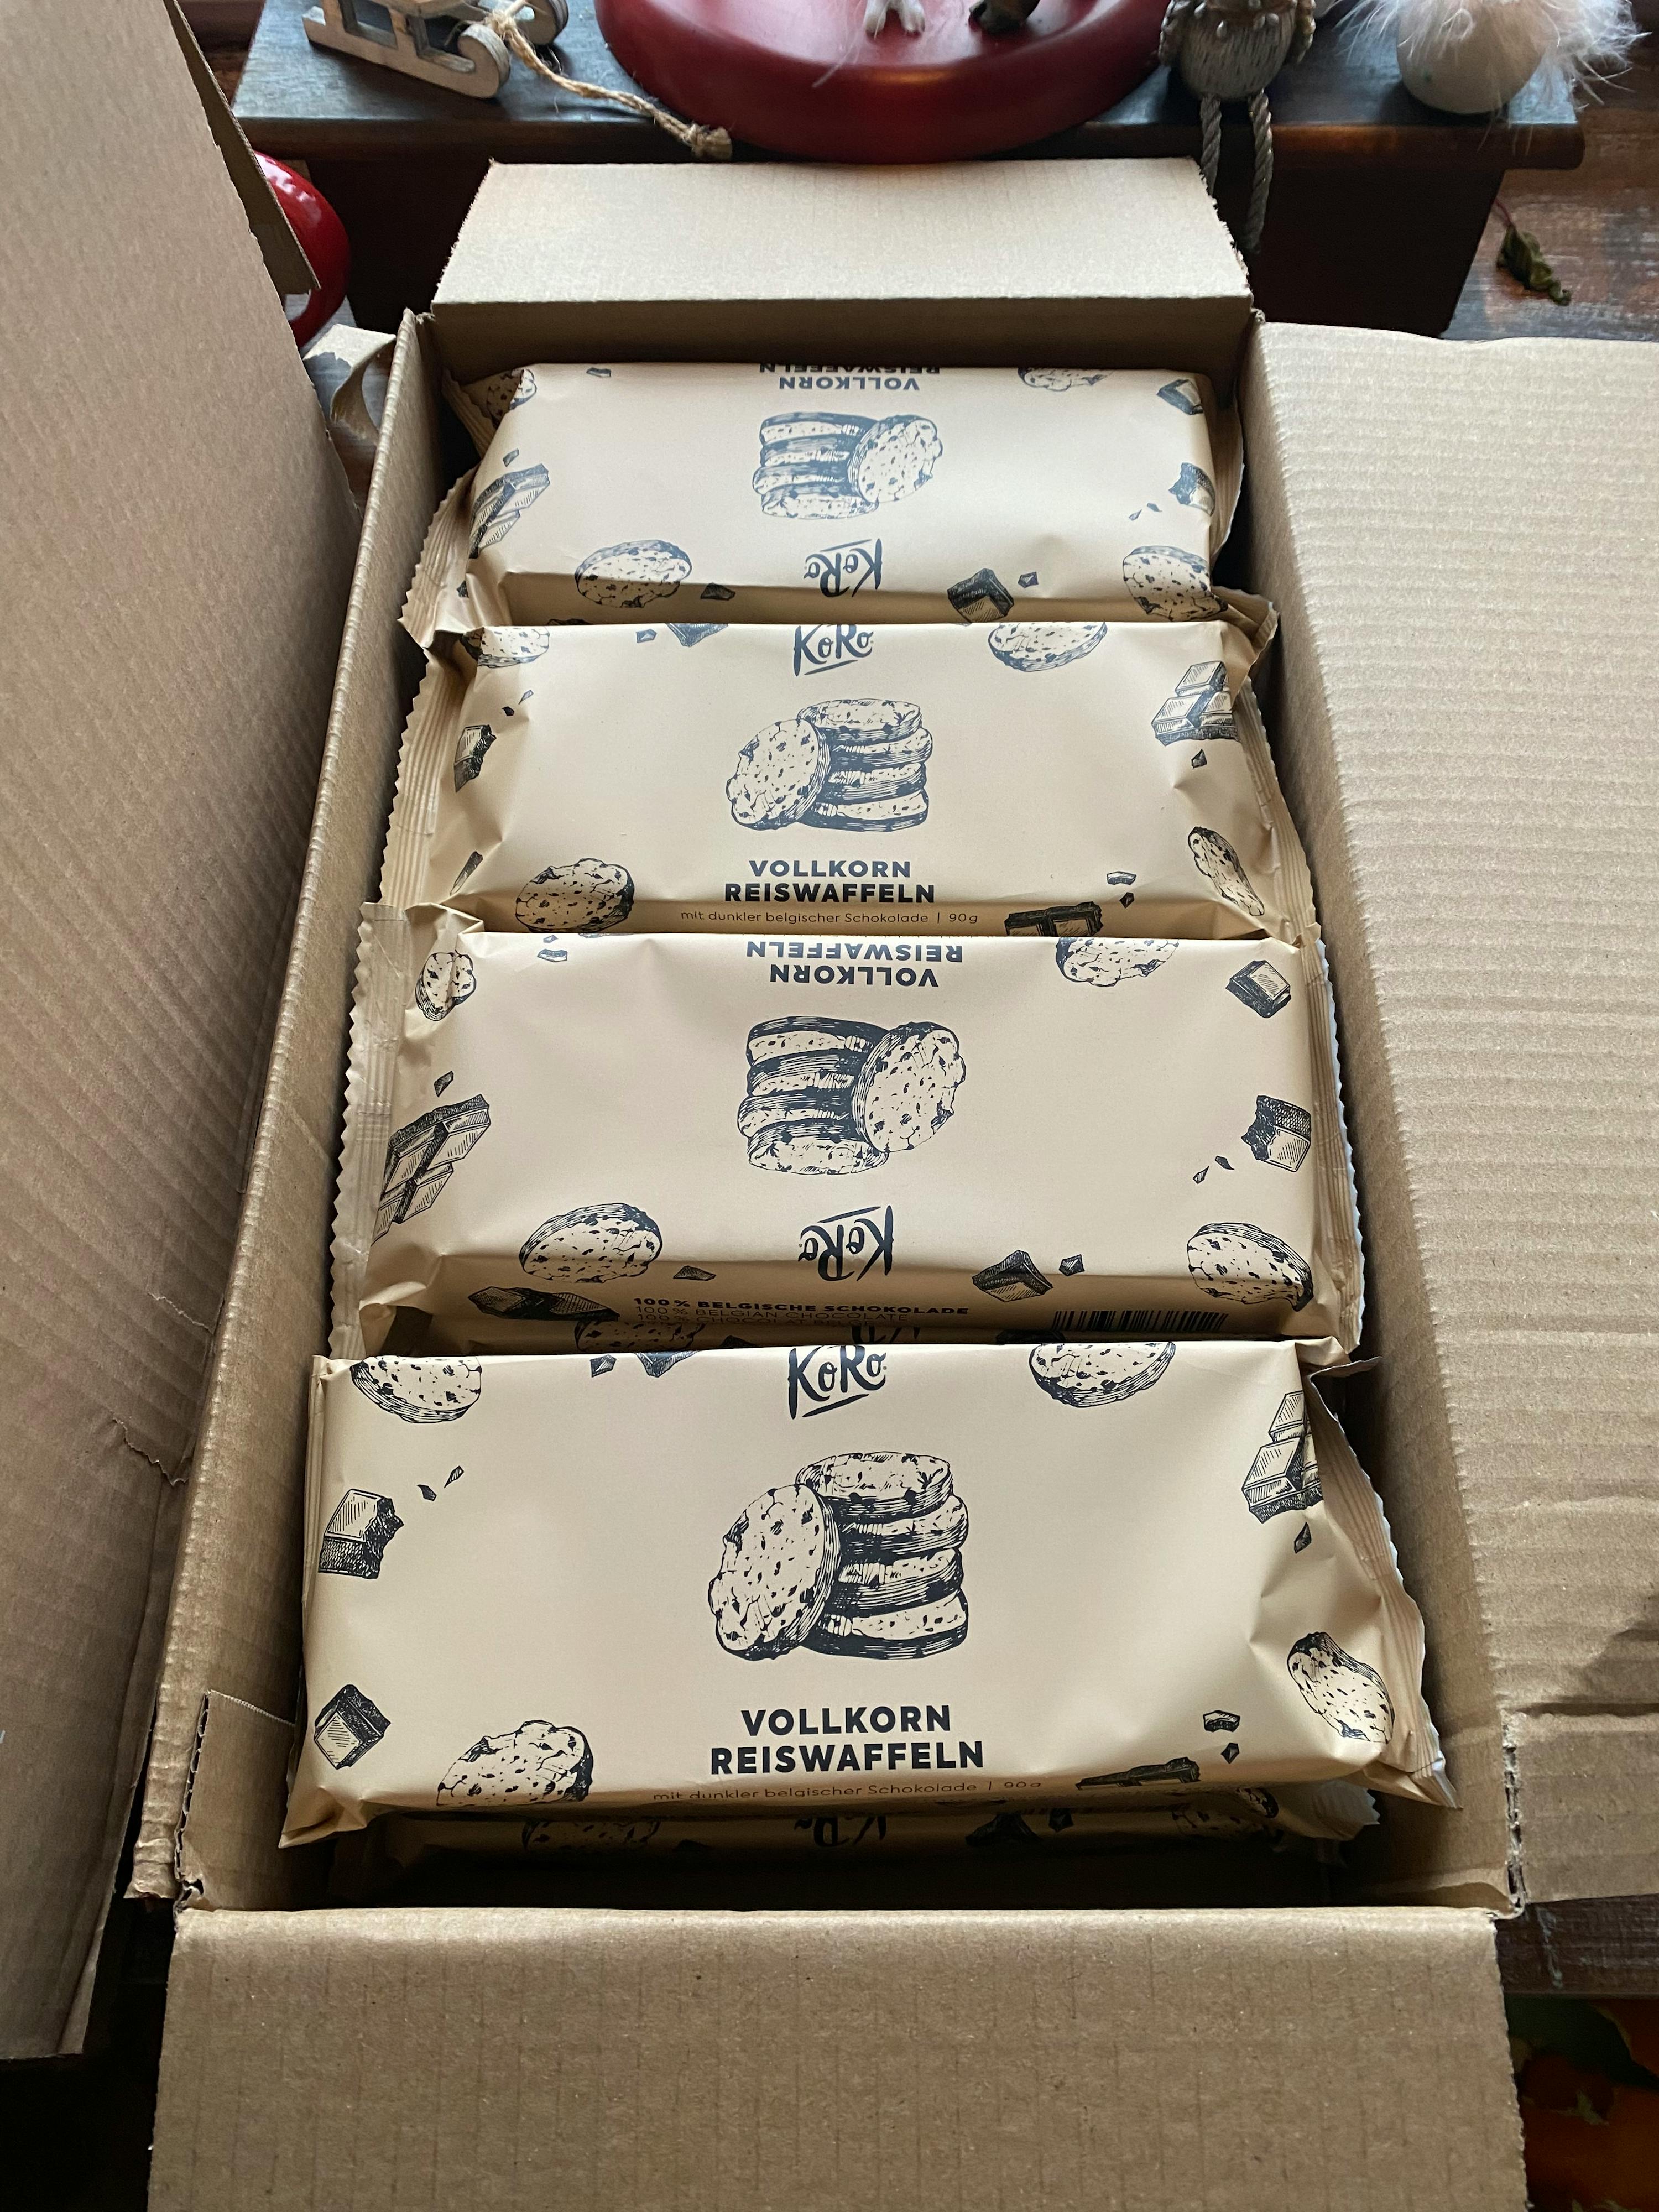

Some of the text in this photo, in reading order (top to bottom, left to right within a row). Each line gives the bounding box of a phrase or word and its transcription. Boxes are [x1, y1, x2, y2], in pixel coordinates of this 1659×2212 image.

[779, 377, 920, 390] VOLLKORN
[804, 538, 883, 597] KoRo
[794, 624, 874, 676] KoRo
[749, 860, 910, 878] VOLLKORN
[724, 883, 935, 904] REISWAFFELN
[681, 911, 705, 920] mit
[708, 911, 761, 921] dunkler
[766, 912, 841, 924] belgischer
[844, 913, 928, 922] Schokolade
[948, 913, 978, 924] 90g
[747, 941, 963, 963] REISWAFFELN
[770, 964, 939, 987] VOLLKORN
[798, 1205, 894, 1281] KoRo
[634, 1297, 670, 1306] 100
[698, 1301, 816, 1311] BELGISCHE
[824, 1305, 969, 1314] SCHOKOLADE
[696, 1309, 778, 1318] BELGIAN
[786, 1312, 907, 1321] CHOCOLATE
[787, 1345, 886, 1420] KoRo
[741, 1705, 951, 1736] VOLLKORN
[711, 1741, 983, 1775] REISWAFFELN
[654, 1792, 682, 1800] mit
[689, 1789, 759, 1799] dunkler
[765, 1785, 862, 1798] belgischer
[868, 1782, 977, 1794] Schokolade
